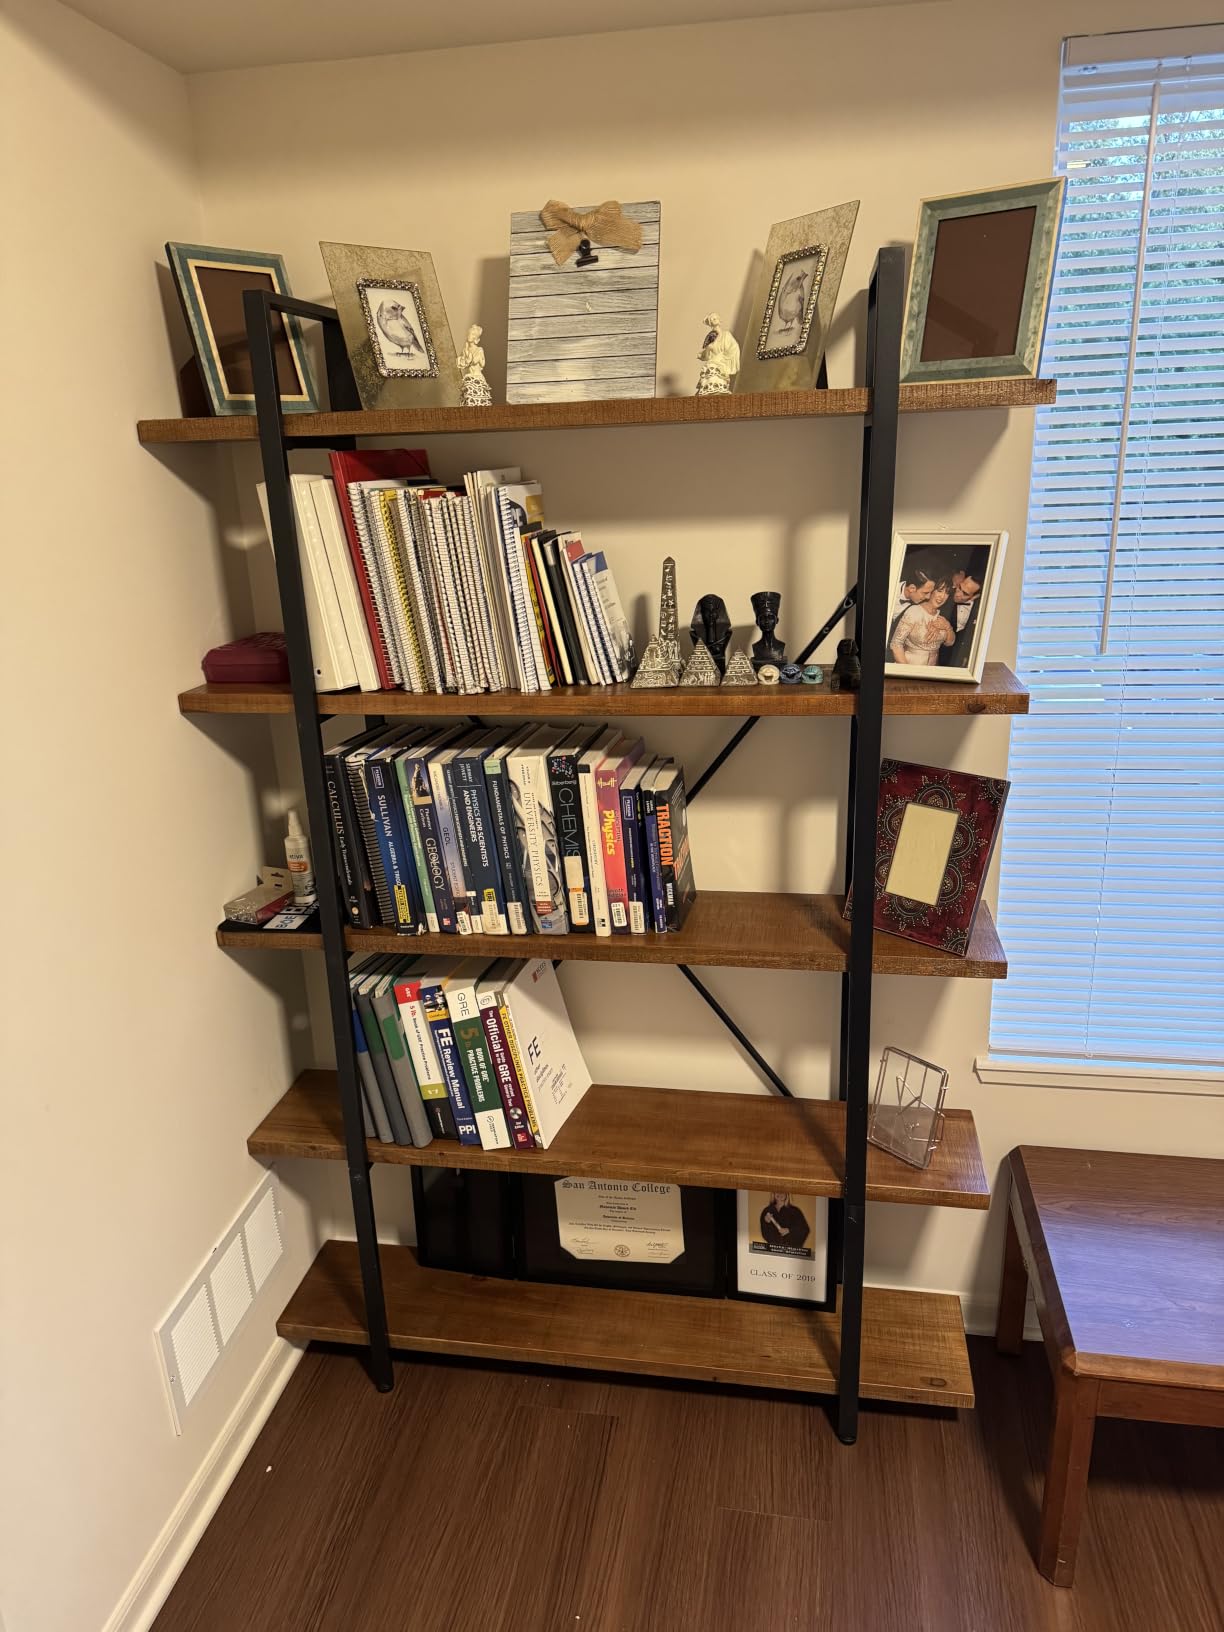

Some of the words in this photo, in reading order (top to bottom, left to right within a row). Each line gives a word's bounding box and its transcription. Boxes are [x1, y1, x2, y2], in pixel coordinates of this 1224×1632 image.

[459, 763, 468, 781] JEWETT
[327, 781, 345, 835] CALCULUS
[463, 789, 471, 806] AND
[471, 789, 480, 816] PHYSICS
[492, 780, 505, 826] FUNDAMENTALS
[378, 795, 393, 837] SULLIVAN
[388, 841, 398, 865] ALGEBRA
[466, 806, 478, 843] ENGINEERS
[475, 816, 483, 832] FOR
[500, 826, 506, 835] OF
[602, 809, 616, 856] Physics
[656, 803, 673, 866] TRACTION
[478, 832, 489, 867] SCIENTISTS
[502, 835, 510, 859] PHYSICS
[524, 792, 538, 847] UNIVERSITY
[531, 850, 544, 887] PHYSICS
[426, 838, 445, 891] GEOLOGY
[457, 992, 470, 1017] GRE
[502, 1012, 508, 1020] FE
[438, 1028, 454, 1047] FE
[461, 1027, 480, 1041] 5
[486, 1018, 504, 1052] Official
[503, 1020, 512, 1038] OTHER
[419, 1043, 427, 1060] Practice
[423, 1060, 431, 1080] Problems
[443, 1048, 456, 1078] Review
[476, 1048, 485, 1063] BOOK
[508, 1038, 522, 1071] DISCIPLINES
[528, 1036, 541, 1066] FE
[467, 1049, 478, 1076] PRACTICE
[473, 1076, 485, 1102] PROBLEMS
[480, 1062, 487, 1070] OF
[498, 1064, 511, 1083] GRE
[451, 1079, 465, 1109] Manual
[503, 1084, 511, 1098] General
[518, 1072, 527, 1097] PRACTICE
[525, 1098, 537, 1127] PROBLEMS
[459, 1124, 476, 1135] PPI
[561, 1180, 585, 1190] San
[589, 1181, 629, 1192] Antonio
[632, 1182, 671, 1195] College
[750, 1269, 777, 1279] CLASS
[781, 1272, 794, 1280] OF
[797, 1274, 816, 1284] 2019
